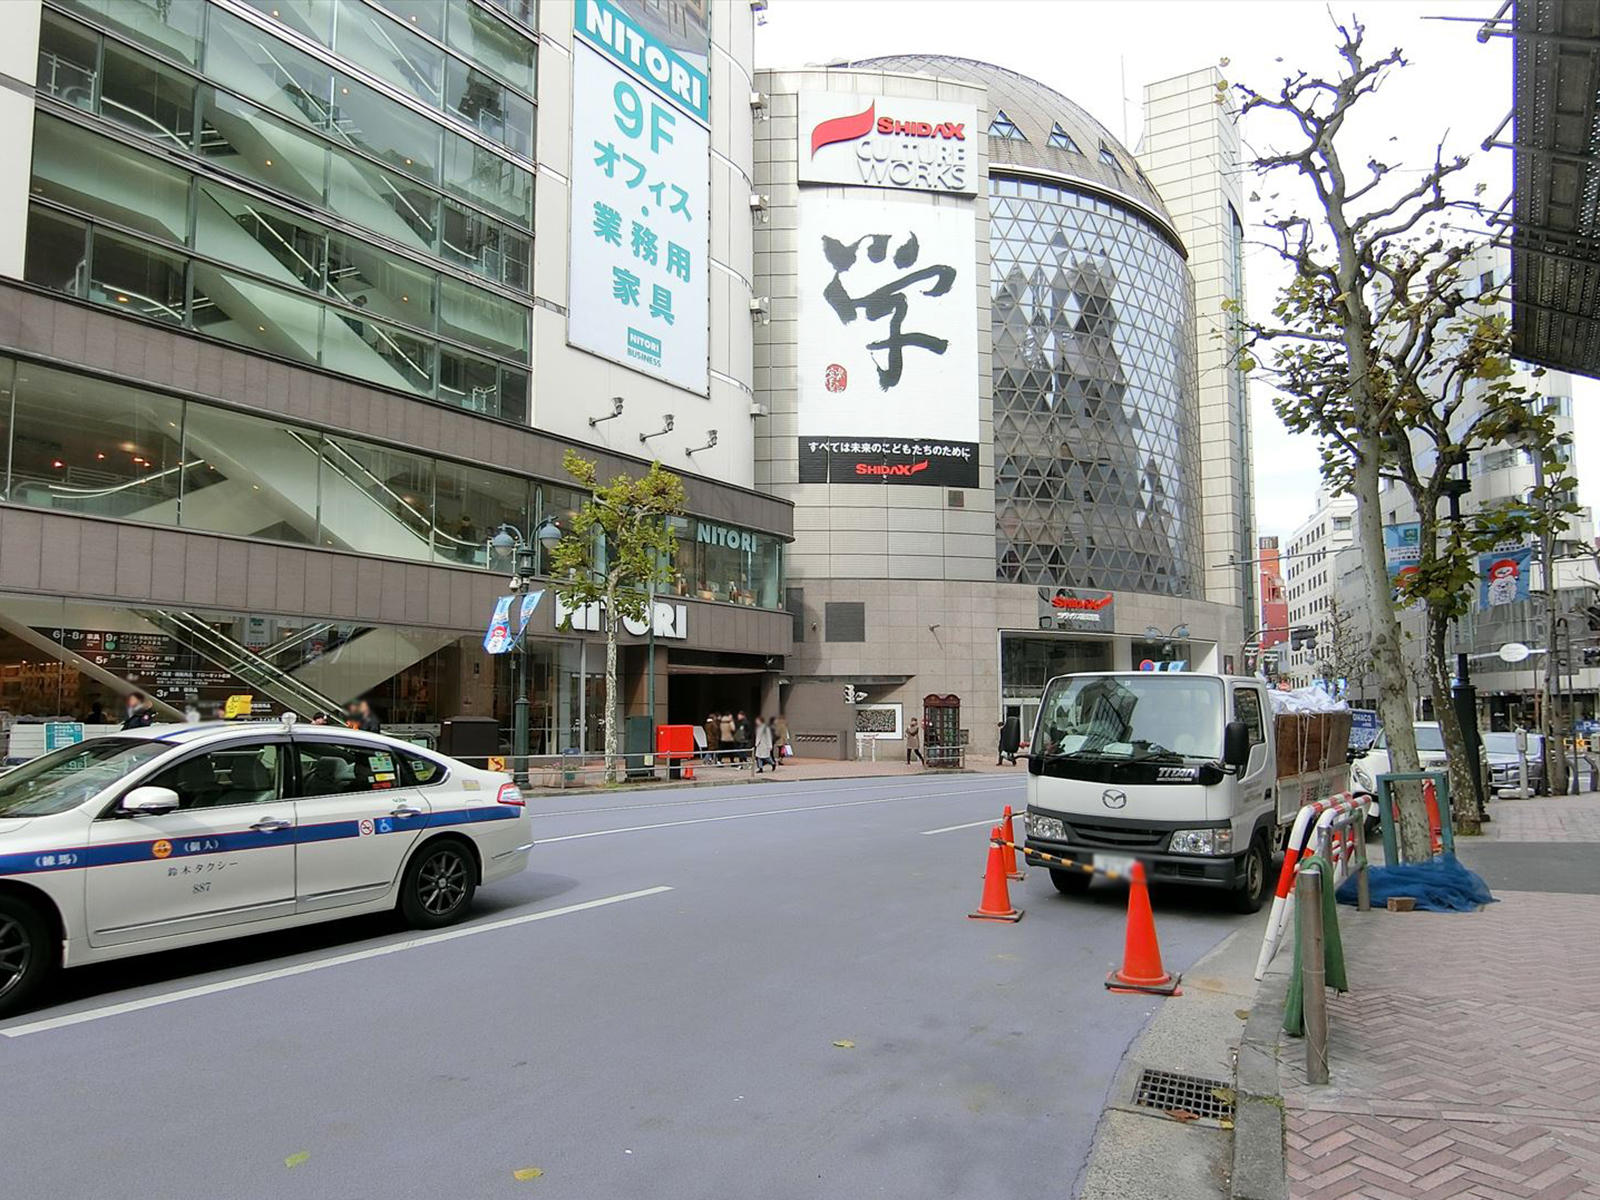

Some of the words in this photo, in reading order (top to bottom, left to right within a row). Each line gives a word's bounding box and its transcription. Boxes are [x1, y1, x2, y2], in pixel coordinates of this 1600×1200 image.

[586, 0, 701, 110] NITORI
[613, 81, 676, 155] 9F
[877, 116, 966, 141] SHIDAX
[856, 140, 965, 165] CULTURE
[593, 140, 693, 223] オフィス
[857, 160, 966, 190] WORKS
[593, 201, 691, 283] 業務用
[612, 265, 675, 326] 家具
[821, 230, 957, 393] 学
[629, 332, 660, 353] NITORI
[627, 348, 661, 368] BUSINESS
[808, 441, 971, 459] すべては未来のこどもたちのために
[855, 463, 912, 476] SHIDAX
[697, 522, 757, 553] NITORI
[95, 655, 109, 664] 5F
[156, 689, 169, 698] 3F
[192, 882, 211, 894] 887
